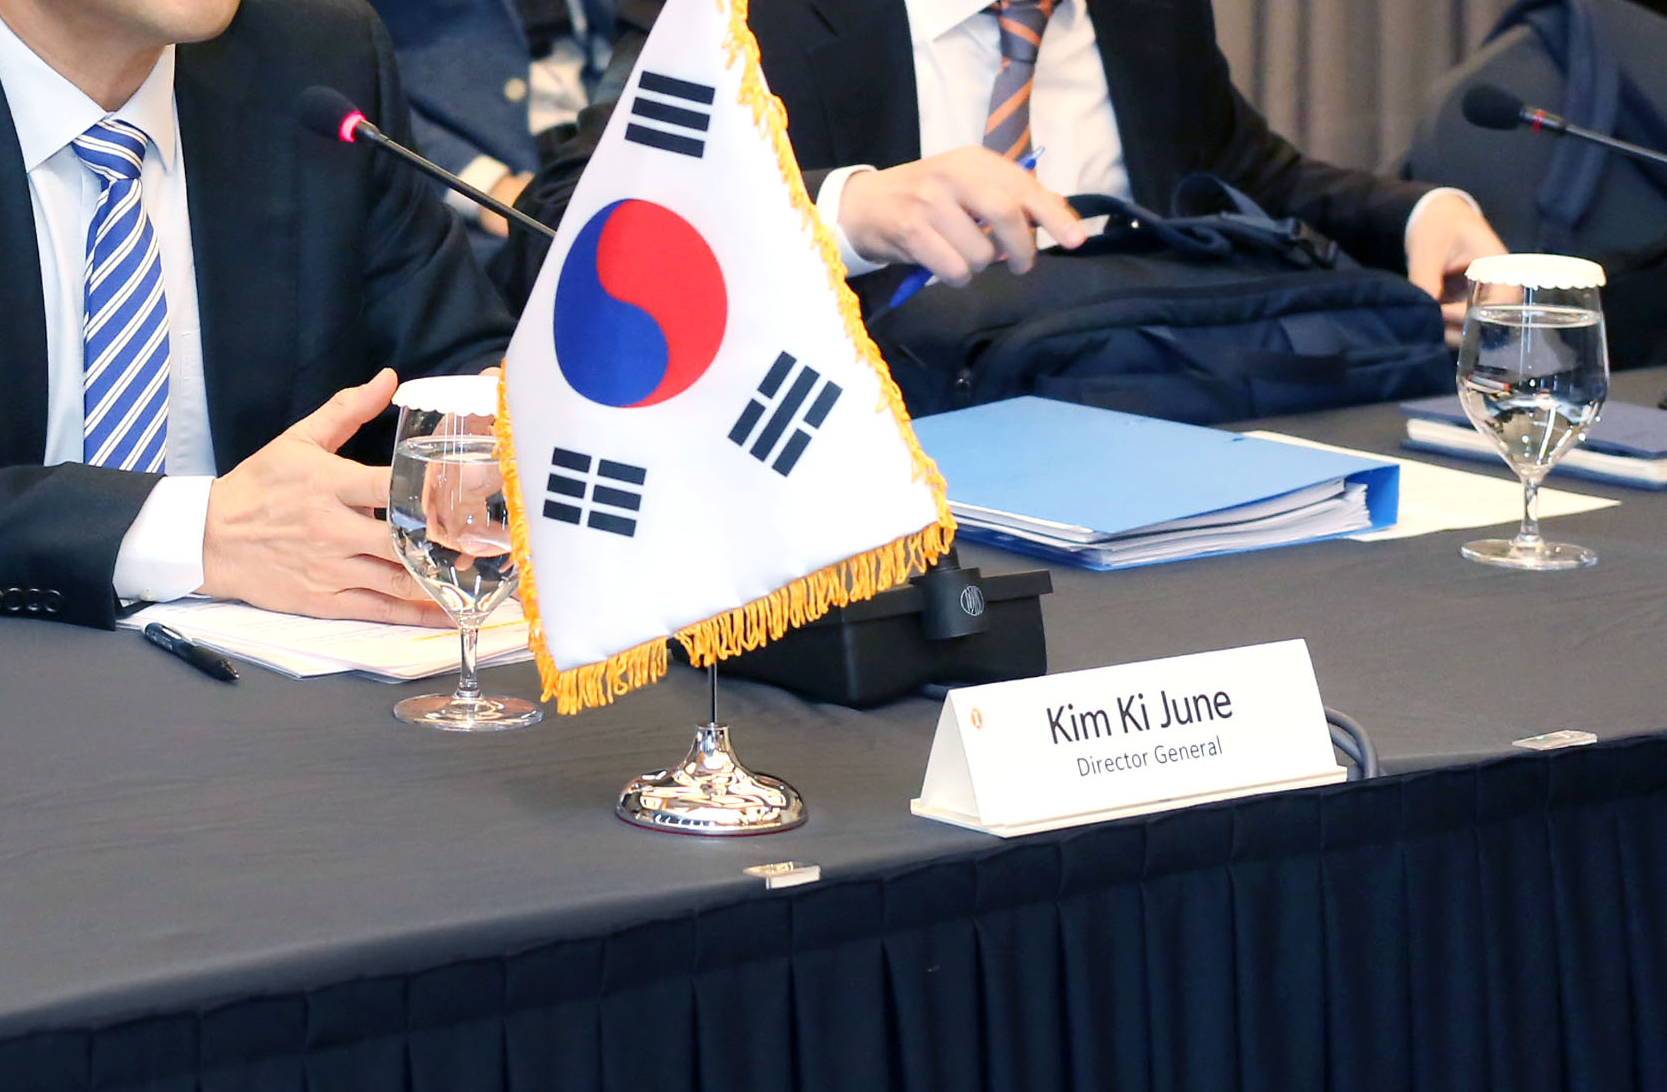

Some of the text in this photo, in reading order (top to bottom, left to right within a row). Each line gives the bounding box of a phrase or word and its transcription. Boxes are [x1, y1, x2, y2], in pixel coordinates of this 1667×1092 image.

[1045, 689, 1233, 745] Kim Ki June
[1076, 735, 1223, 777] Director General
